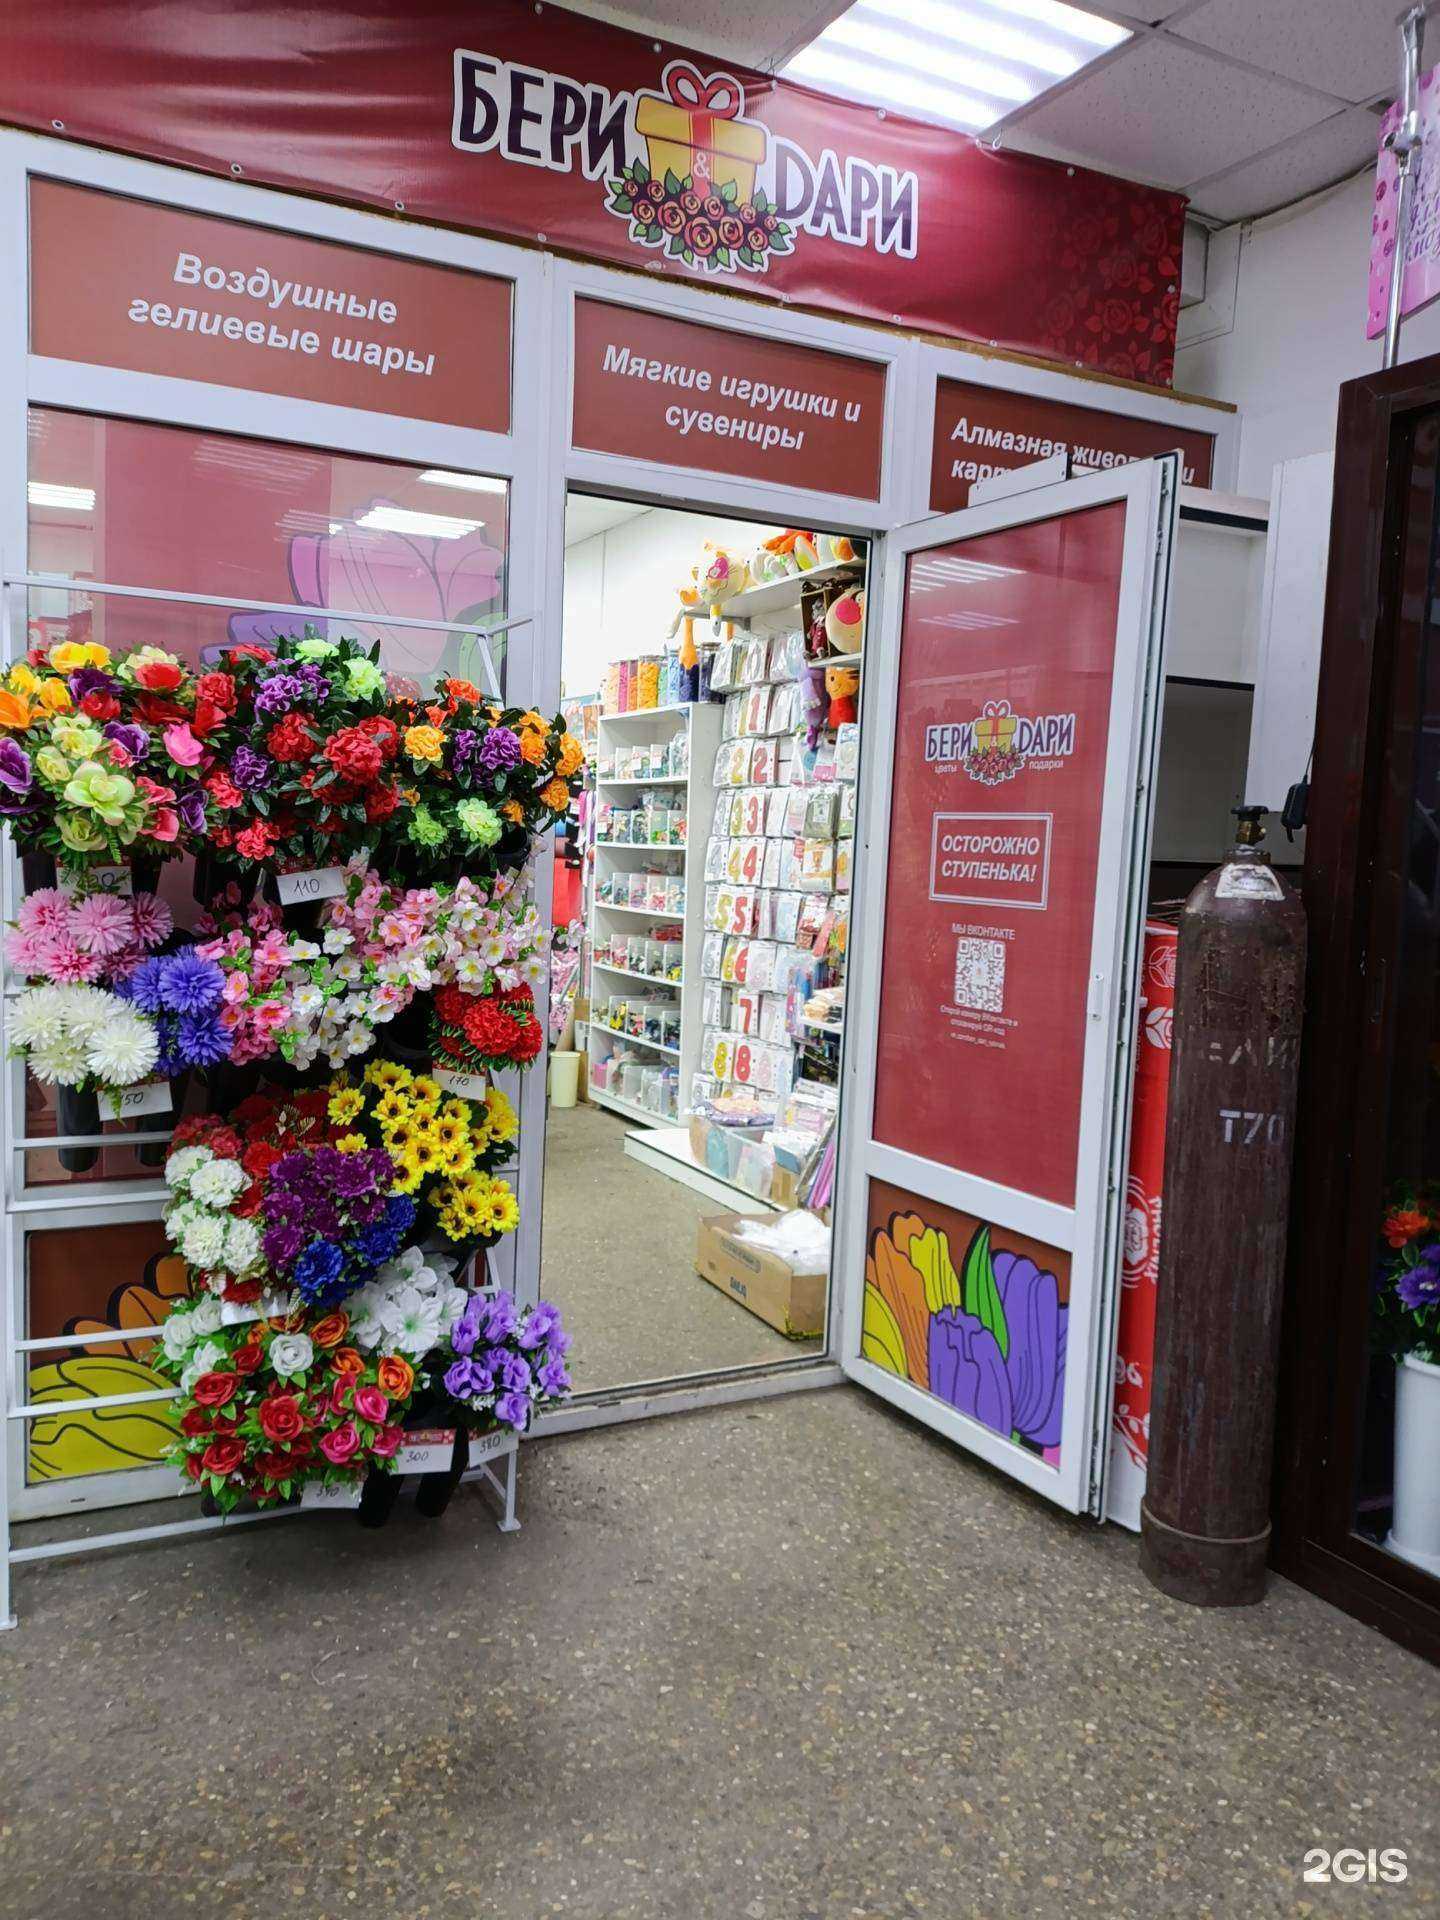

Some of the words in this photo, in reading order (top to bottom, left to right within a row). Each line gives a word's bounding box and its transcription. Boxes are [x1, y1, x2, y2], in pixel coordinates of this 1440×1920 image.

[460, 56, 632, 178] БЕРИ
[693, 151, 710, 179] &
[173, 252, 398, 324] Воздушные
[127, 298, 320, 354] гелиевые
[331, 335, 436, 375] шары
[602, 344, 712, 392] Мягкие
[719, 375, 838, 418] игрушки
[844, 402, 862, 422] и
[665, 405, 804, 450] сувениры
[951, 417, 1067, 458] Алмазная
[927, 724, 973, 758] БЕРИ
[731, 747, 744, 784] 2
[753, 747, 768, 784] 2
[732, 797, 744, 834] 3
[747, 796, 759, 834] 3
[942, 834, 1040, 856] ОСТОРОЖНО
[728, 847, 740, 882] 4
[743, 845, 757, 883] 4
[942, 859, 1038, 882] СТУПЕНЬКА!
[715, 894, 732, 930] 5
[732, 896, 748, 933] 5
[967, 925, 1016, 941] ВКОНТАКТЕ
[734, 947, 749, 983] 6
[739, 998, 752, 1034] 7
[713, 1042, 727, 1079] 8
[736, 1045, 751, 1082] 8
